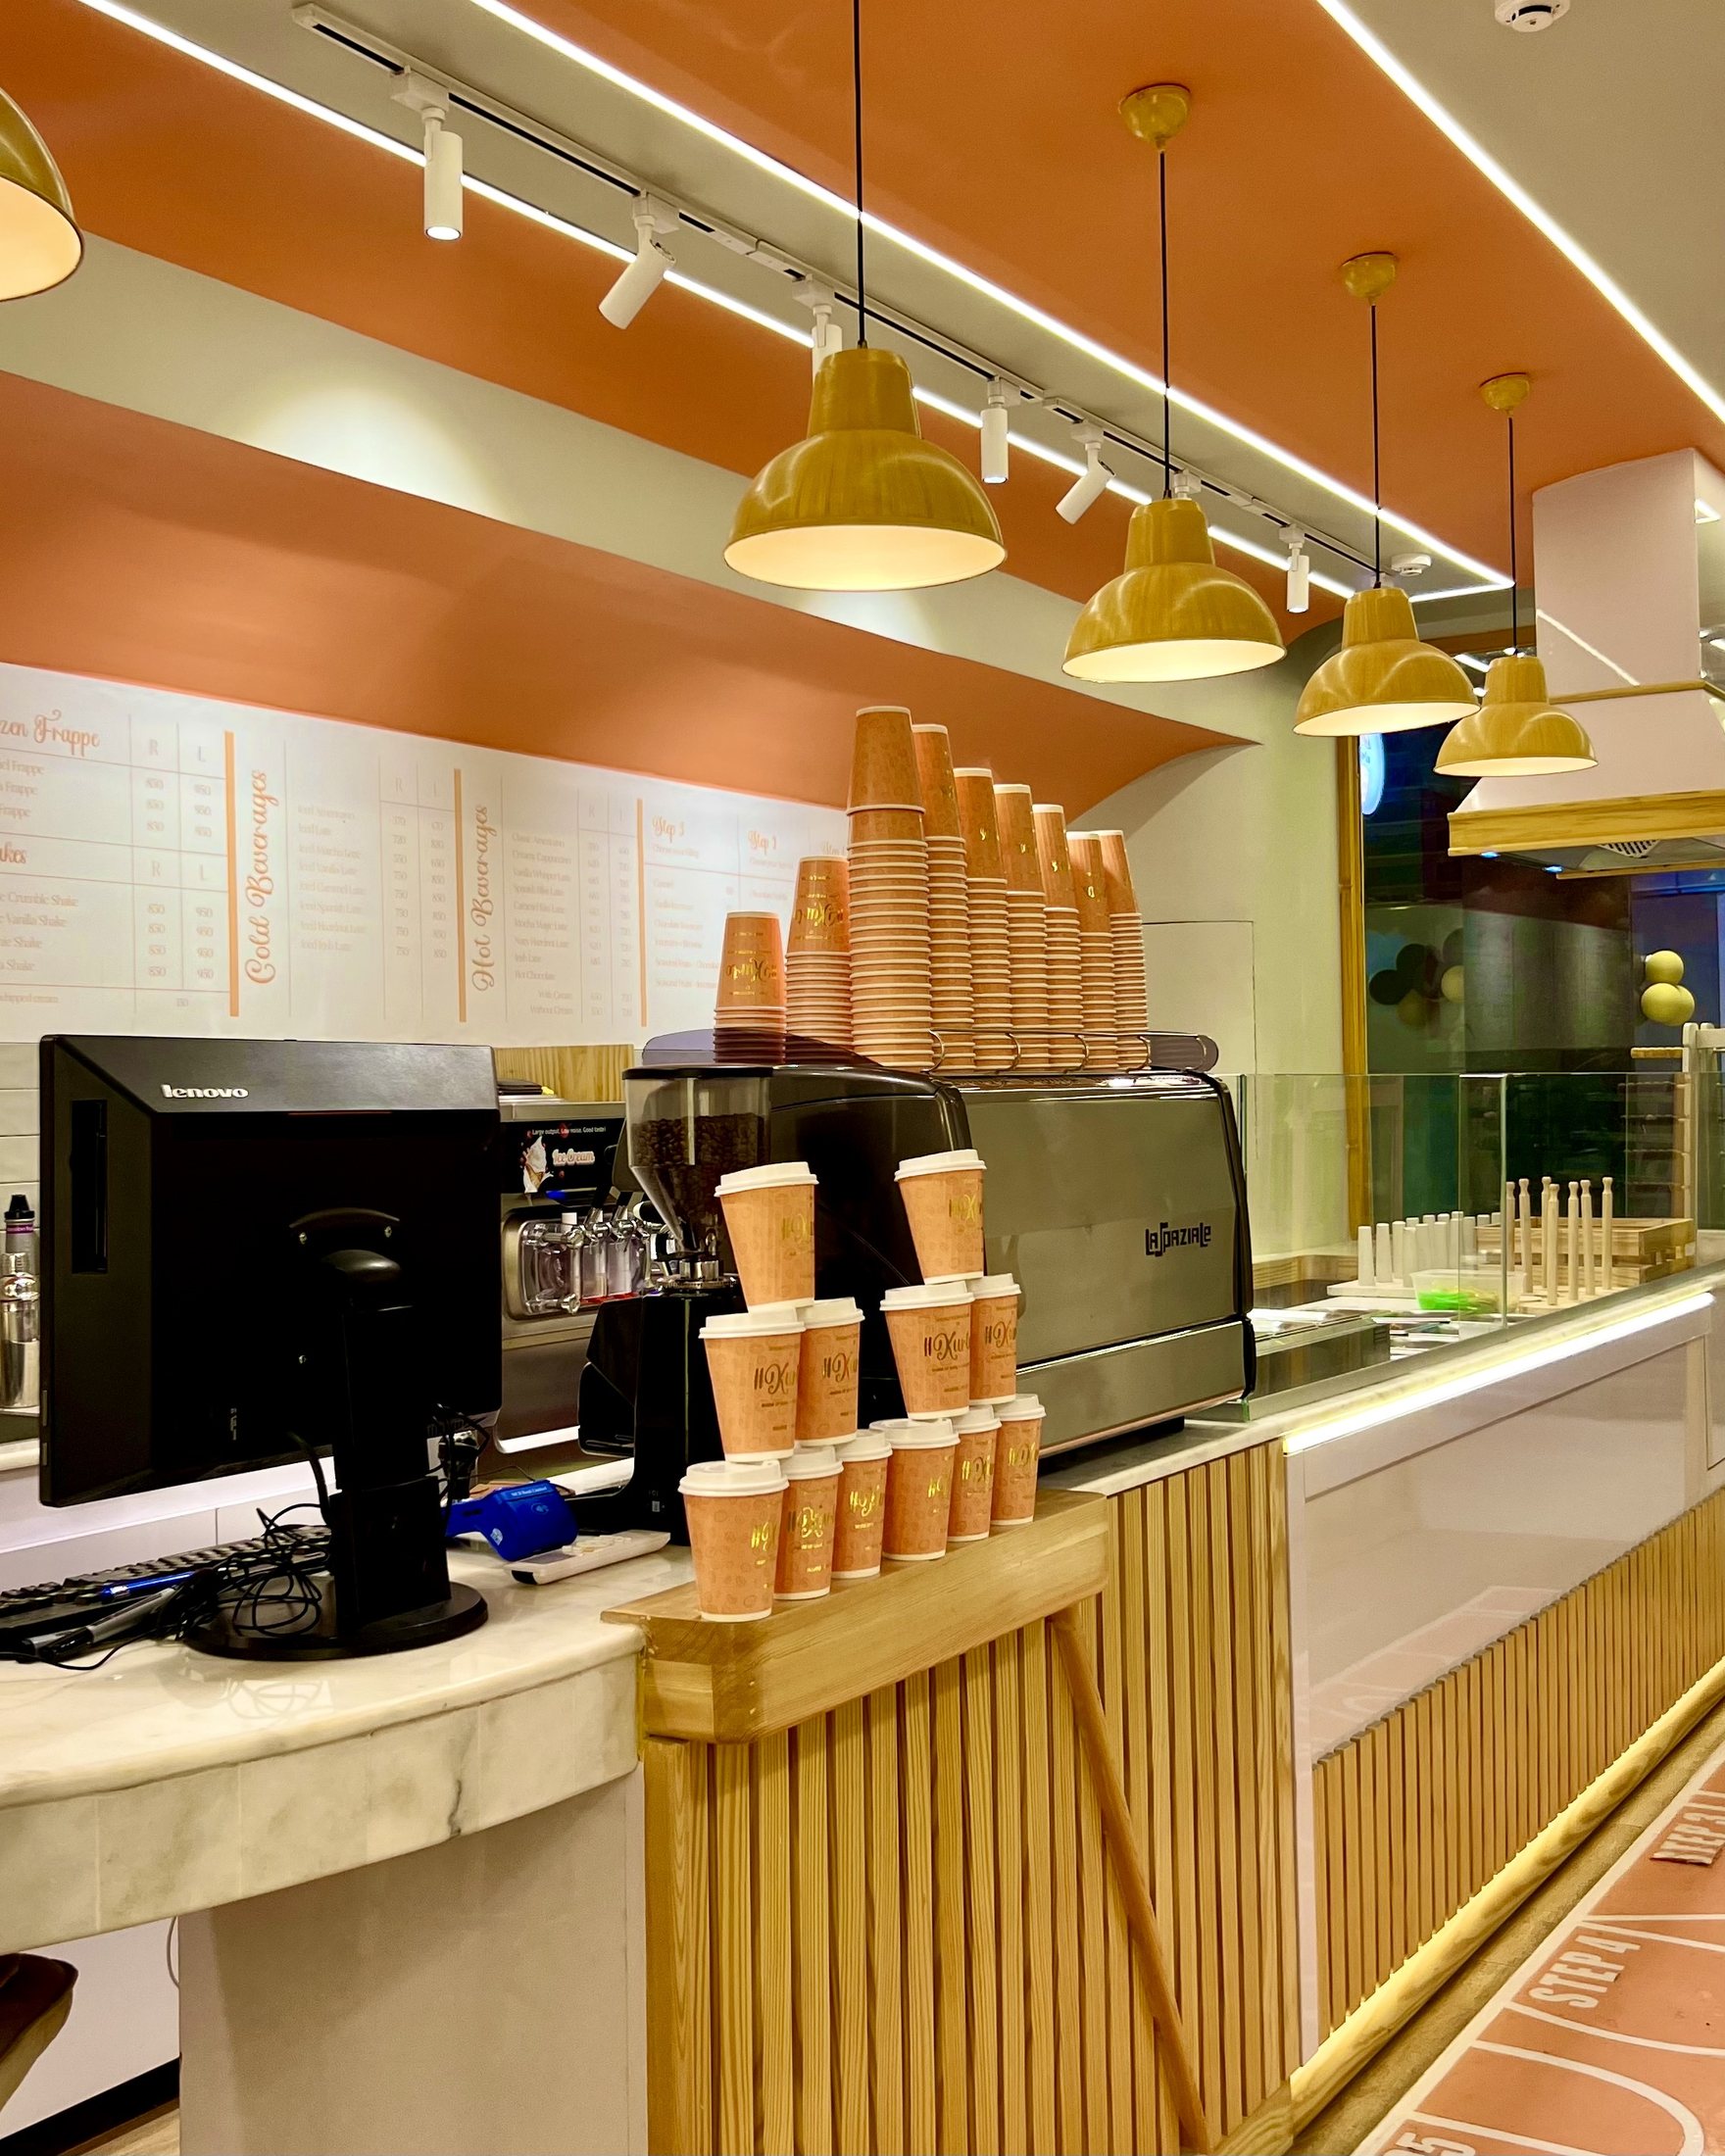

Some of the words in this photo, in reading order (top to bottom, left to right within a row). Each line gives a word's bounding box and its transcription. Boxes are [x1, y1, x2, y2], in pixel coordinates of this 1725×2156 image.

[34, 709, 100, 757] Frappe
[244, 768, 279, 908] Beverages
[470, 804, 497, 927] Beverages
[244, 914, 276, 984] Cold
[470, 933, 495, 992] Hot
[161, 1084, 249, 1099] lenovo
[1575, 1935, 1641, 1955] 4
[1528, 1950, 1625, 2009] STEP
